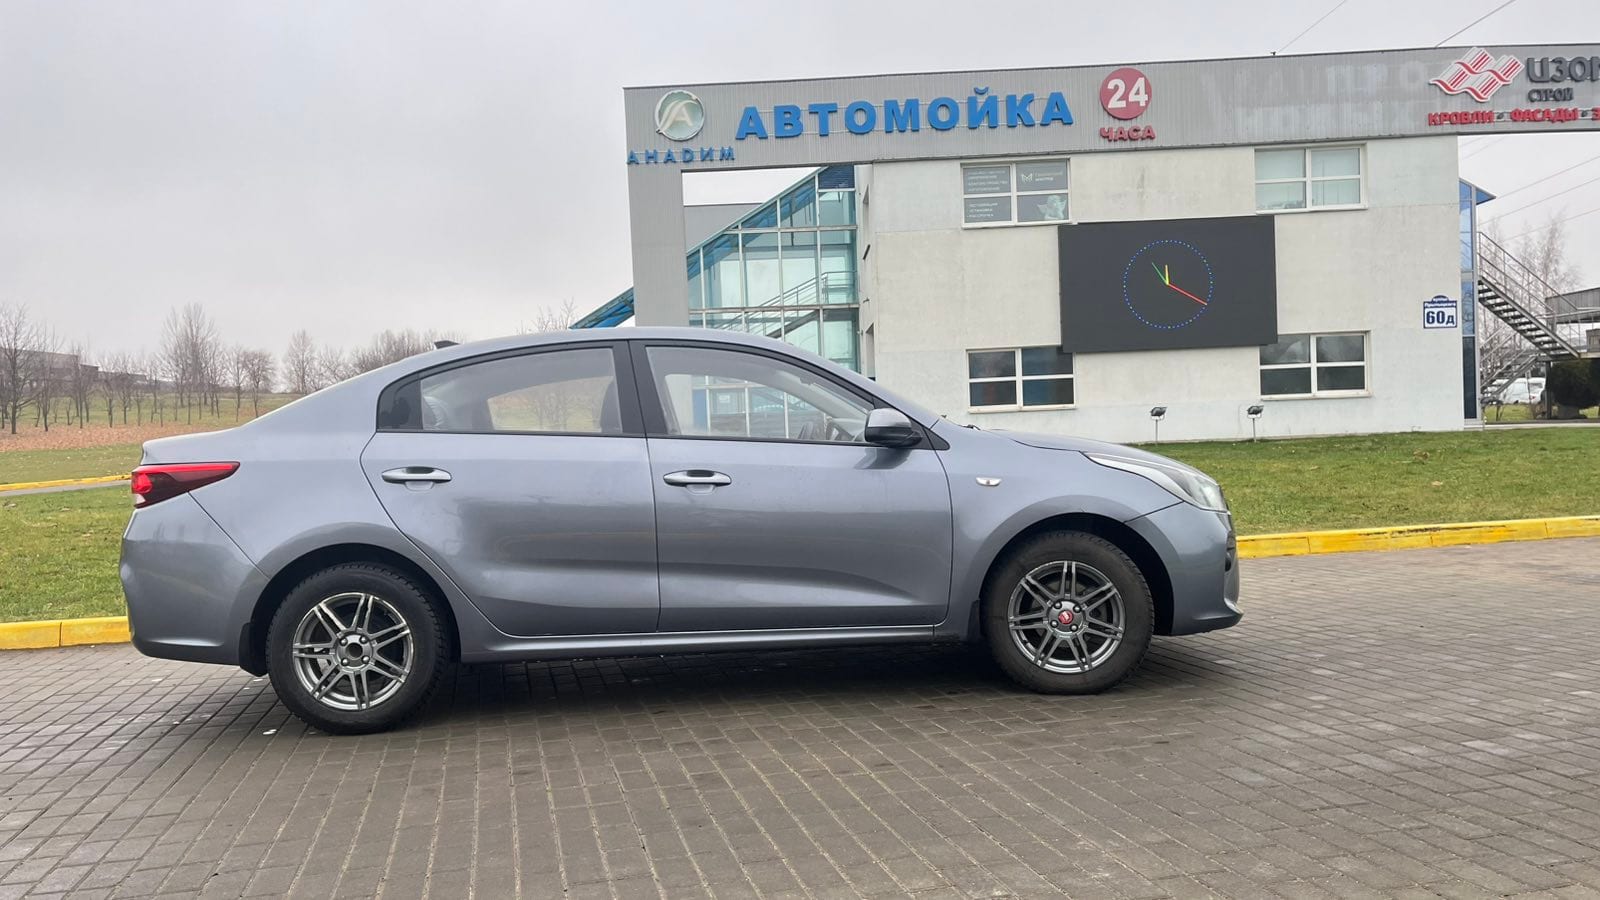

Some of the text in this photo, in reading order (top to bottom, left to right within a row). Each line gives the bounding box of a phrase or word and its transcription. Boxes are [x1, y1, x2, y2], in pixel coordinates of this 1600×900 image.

[1107, 77, 1149, 109] 24
[735, 87, 1074, 140] АВТОМОЙКА
[1428, 111, 1495, 126] КРОВЛИ
[1510, 107, 1579, 123] ФАСАДЫ
[1099, 125, 1156, 142] ЧАСА
